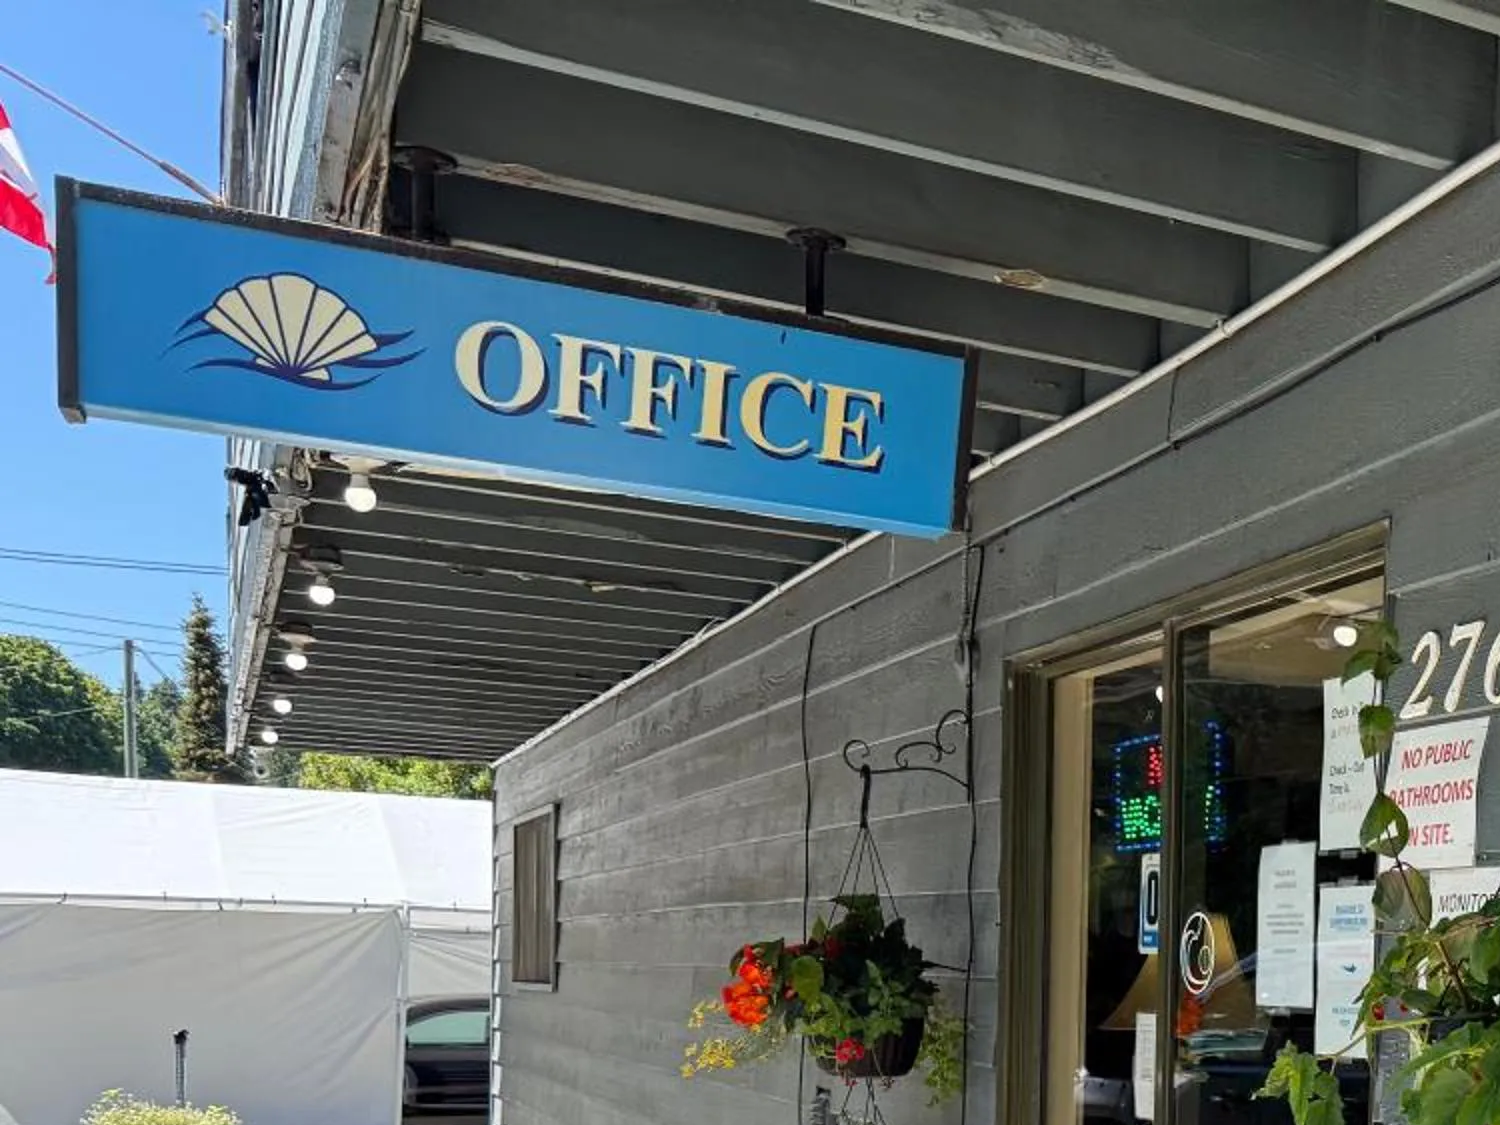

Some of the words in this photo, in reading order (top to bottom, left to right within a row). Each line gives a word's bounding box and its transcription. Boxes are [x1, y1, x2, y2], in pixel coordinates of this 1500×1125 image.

[454, 320, 886, 471] OFFICE
[1401, 748, 1423, 771] NO
[1425, 739, 1475, 765] PUBLIC
[1421, 823, 1454, 846] SITE.
